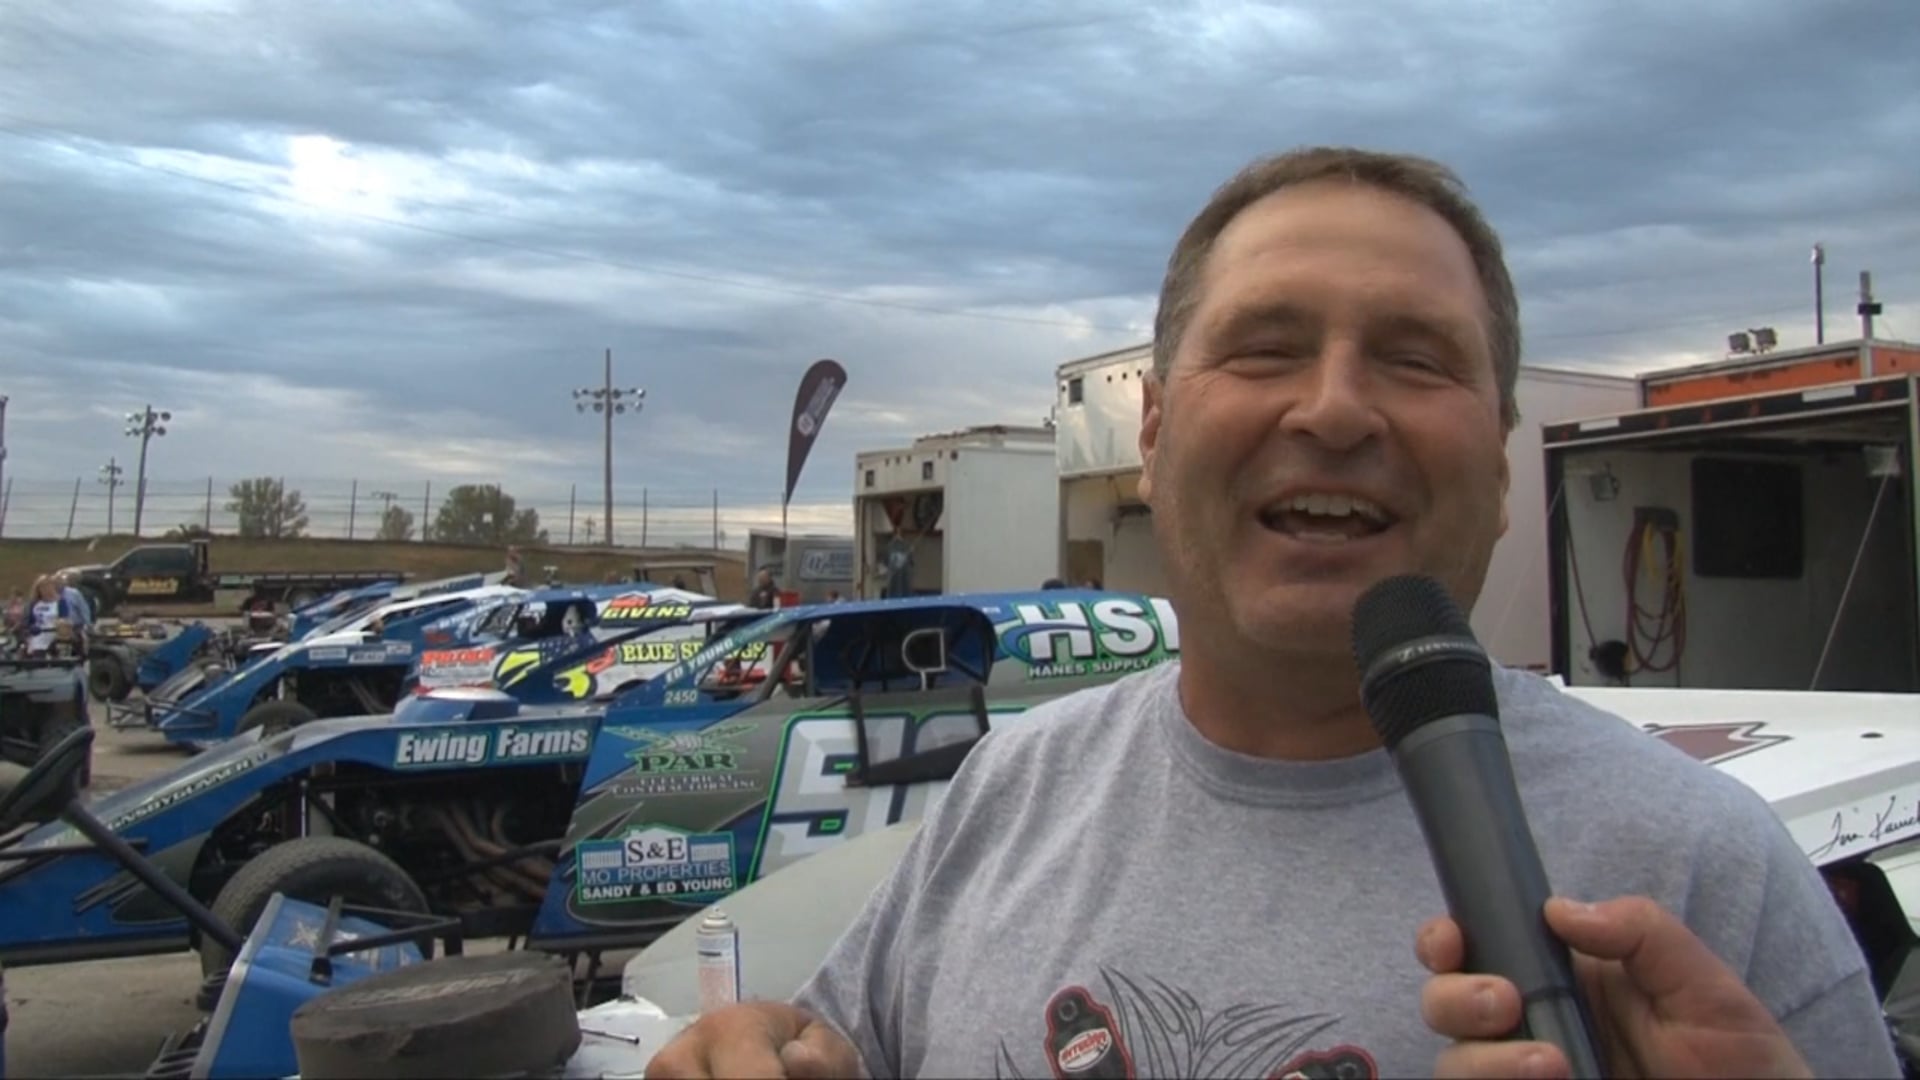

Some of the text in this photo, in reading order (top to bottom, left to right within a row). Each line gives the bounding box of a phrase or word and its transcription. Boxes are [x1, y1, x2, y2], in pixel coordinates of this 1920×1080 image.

[602, 605, 690, 620] GIVENS
[621, 640, 767, 662] BLUE SPGS
[665, 637, 734, 684] ED YOUNG
[1029, 664, 1085, 678] HANES
[1092, 659, 1150, 673] SUPPLY
[664, 689, 698, 706] 2450
[397, 728, 588, 763] Ewing Farms
[637, 751, 737, 773] PAR
[627, 837, 686, 864] S&E
[582, 860, 731, 885] MO PROPERTIES
[583, 876, 733, 900] SANDY & ED YOUNG
